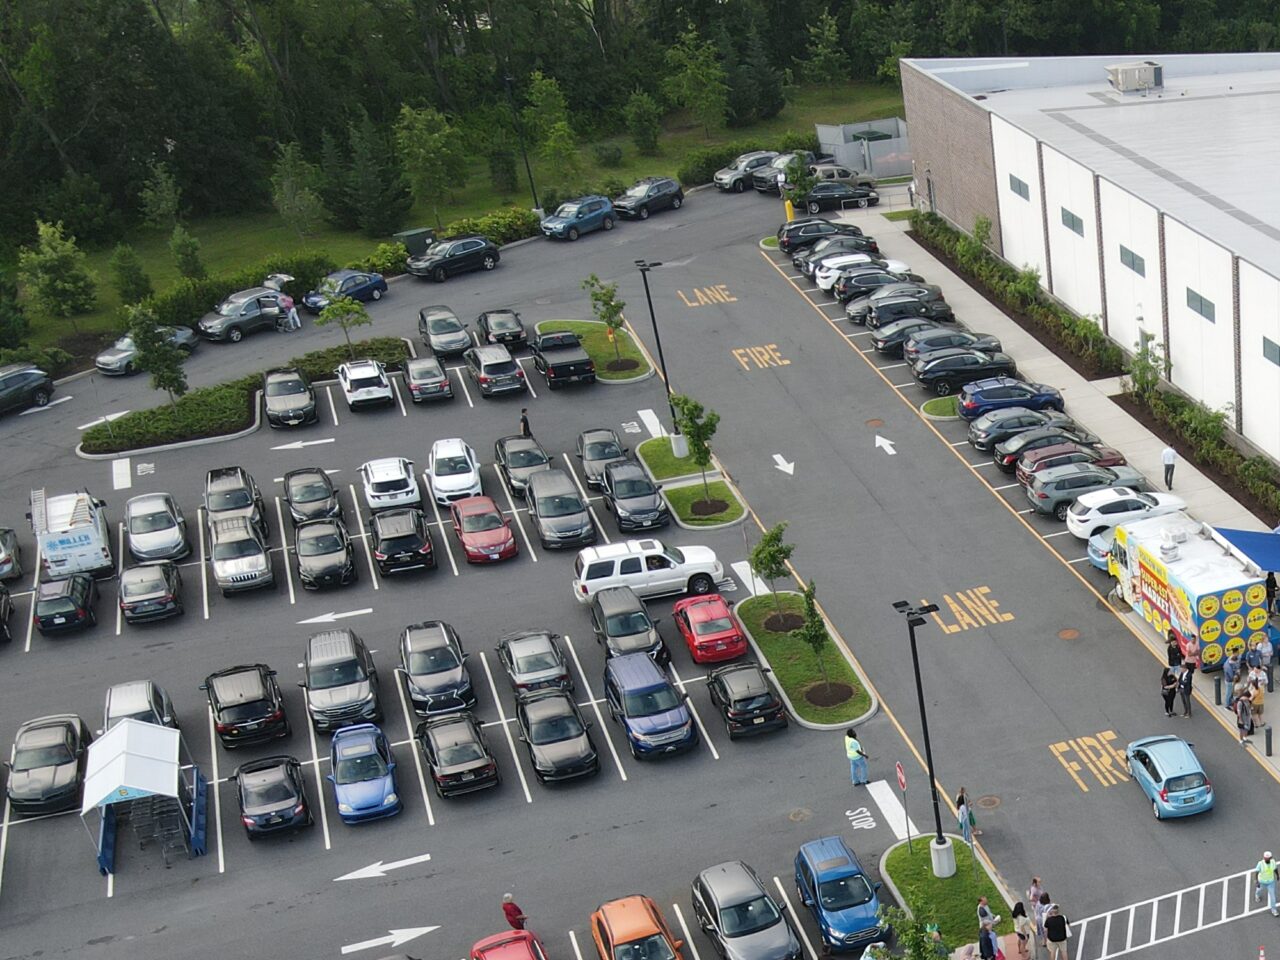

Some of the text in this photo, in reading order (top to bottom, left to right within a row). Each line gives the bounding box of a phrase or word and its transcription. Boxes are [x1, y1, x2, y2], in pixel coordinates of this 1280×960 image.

[677, 284, 738, 308] LANE
[731, 344, 791, 371] FIRE
[921, 586, 1015, 634] LANE
[1141, 579, 1169, 614] MARKET
[1049, 730, 1133, 792] FIRE
[845, 807, 876, 830] STOP
